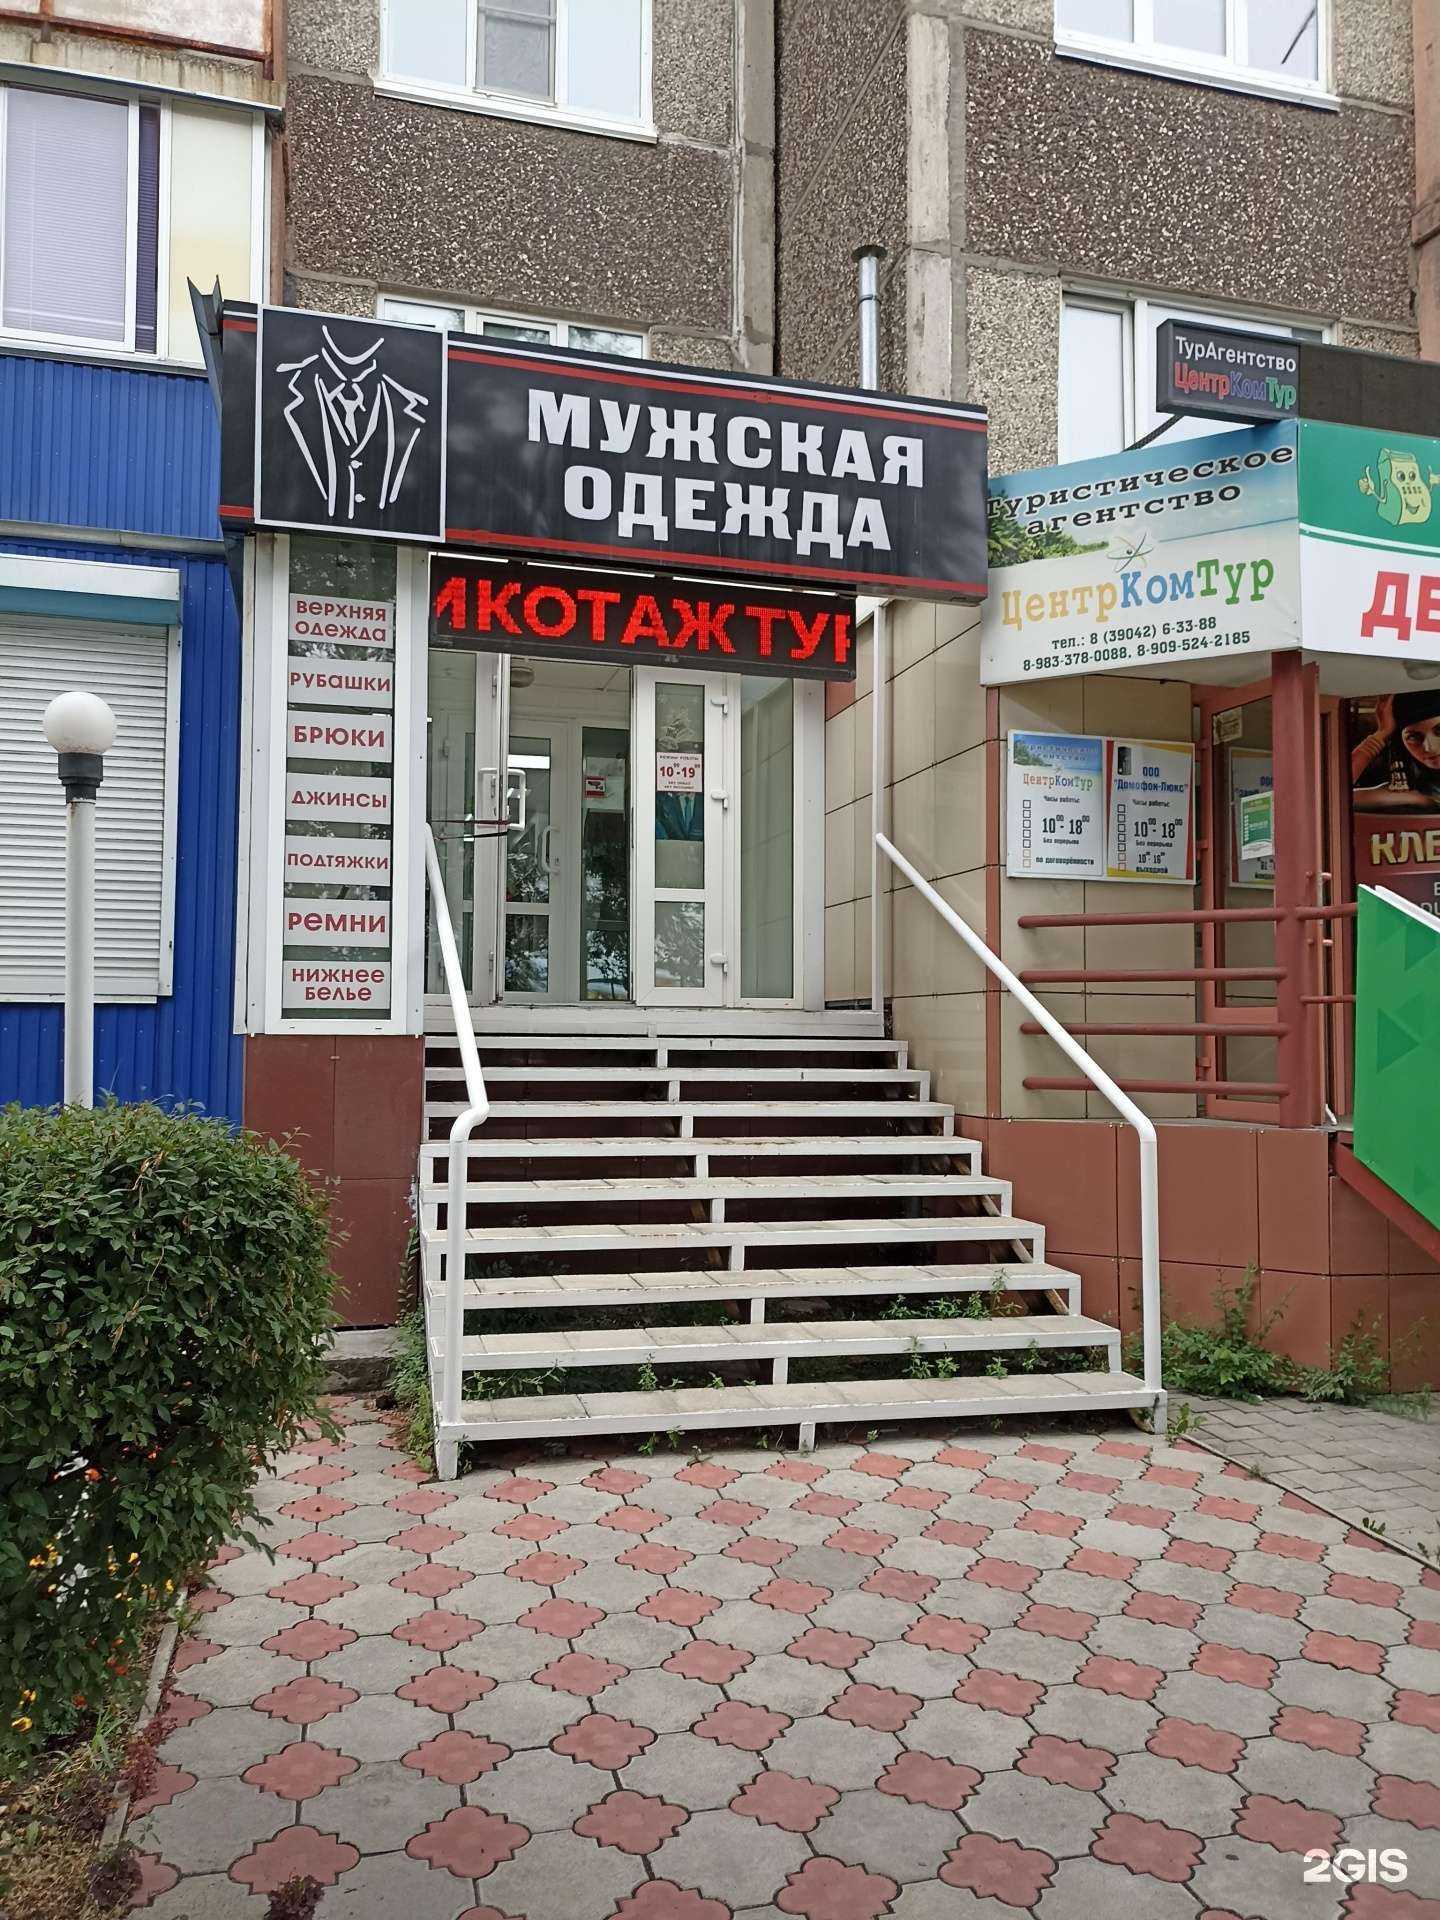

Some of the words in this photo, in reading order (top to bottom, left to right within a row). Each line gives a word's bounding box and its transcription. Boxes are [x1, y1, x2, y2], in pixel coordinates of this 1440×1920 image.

[1175, 336, 1297, 373] ТурАгентство
[1174, 361, 1297, 410] ЦентрКомТур
[528, 388, 925, 489] МУЖСКАЯ
[563, 464, 892, 560] ОДЕЖДА
[1027, 484, 1242, 535] агентство
[1001, 558, 1275, 631] ЦентрКомТур
[1090, 632, 1098, 645] 8
[1103, 625, 1157, 645] (39042)
[1162, 616, 1217, 636] 6-33-88
[1137, 630, 1251, 657] 8-909-524-2185
[294, 725, 385, 748] БРЮКИ
